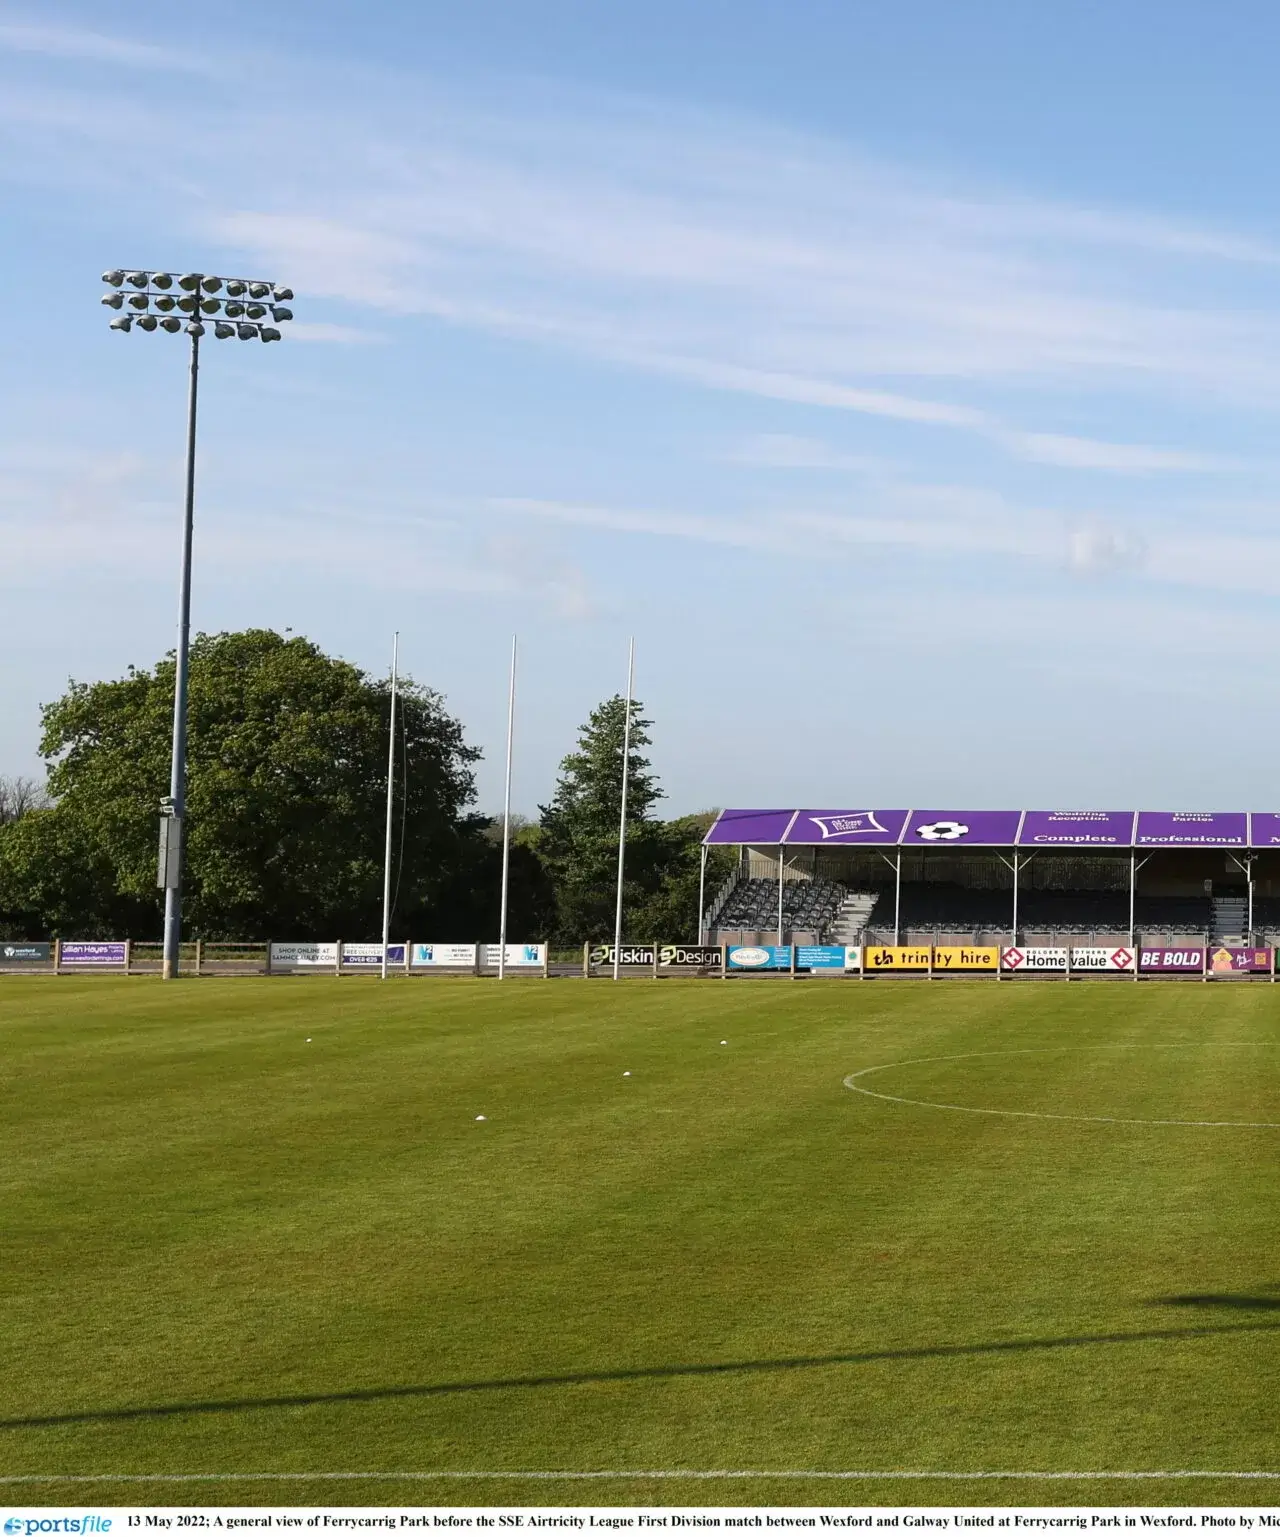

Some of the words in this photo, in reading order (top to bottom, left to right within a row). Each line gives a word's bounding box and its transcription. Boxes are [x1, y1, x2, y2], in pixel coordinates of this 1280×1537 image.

[1033, 834, 1117, 843] Complete
[1139, 835, 1242, 843] Professional
[84, 945, 108, 954] Hayes
[676, 949, 721, 966] Design
[960, 950, 991, 964] hire
[1140, 952, 1160, 966] BE
[1163, 952, 1201, 966] BOLD
